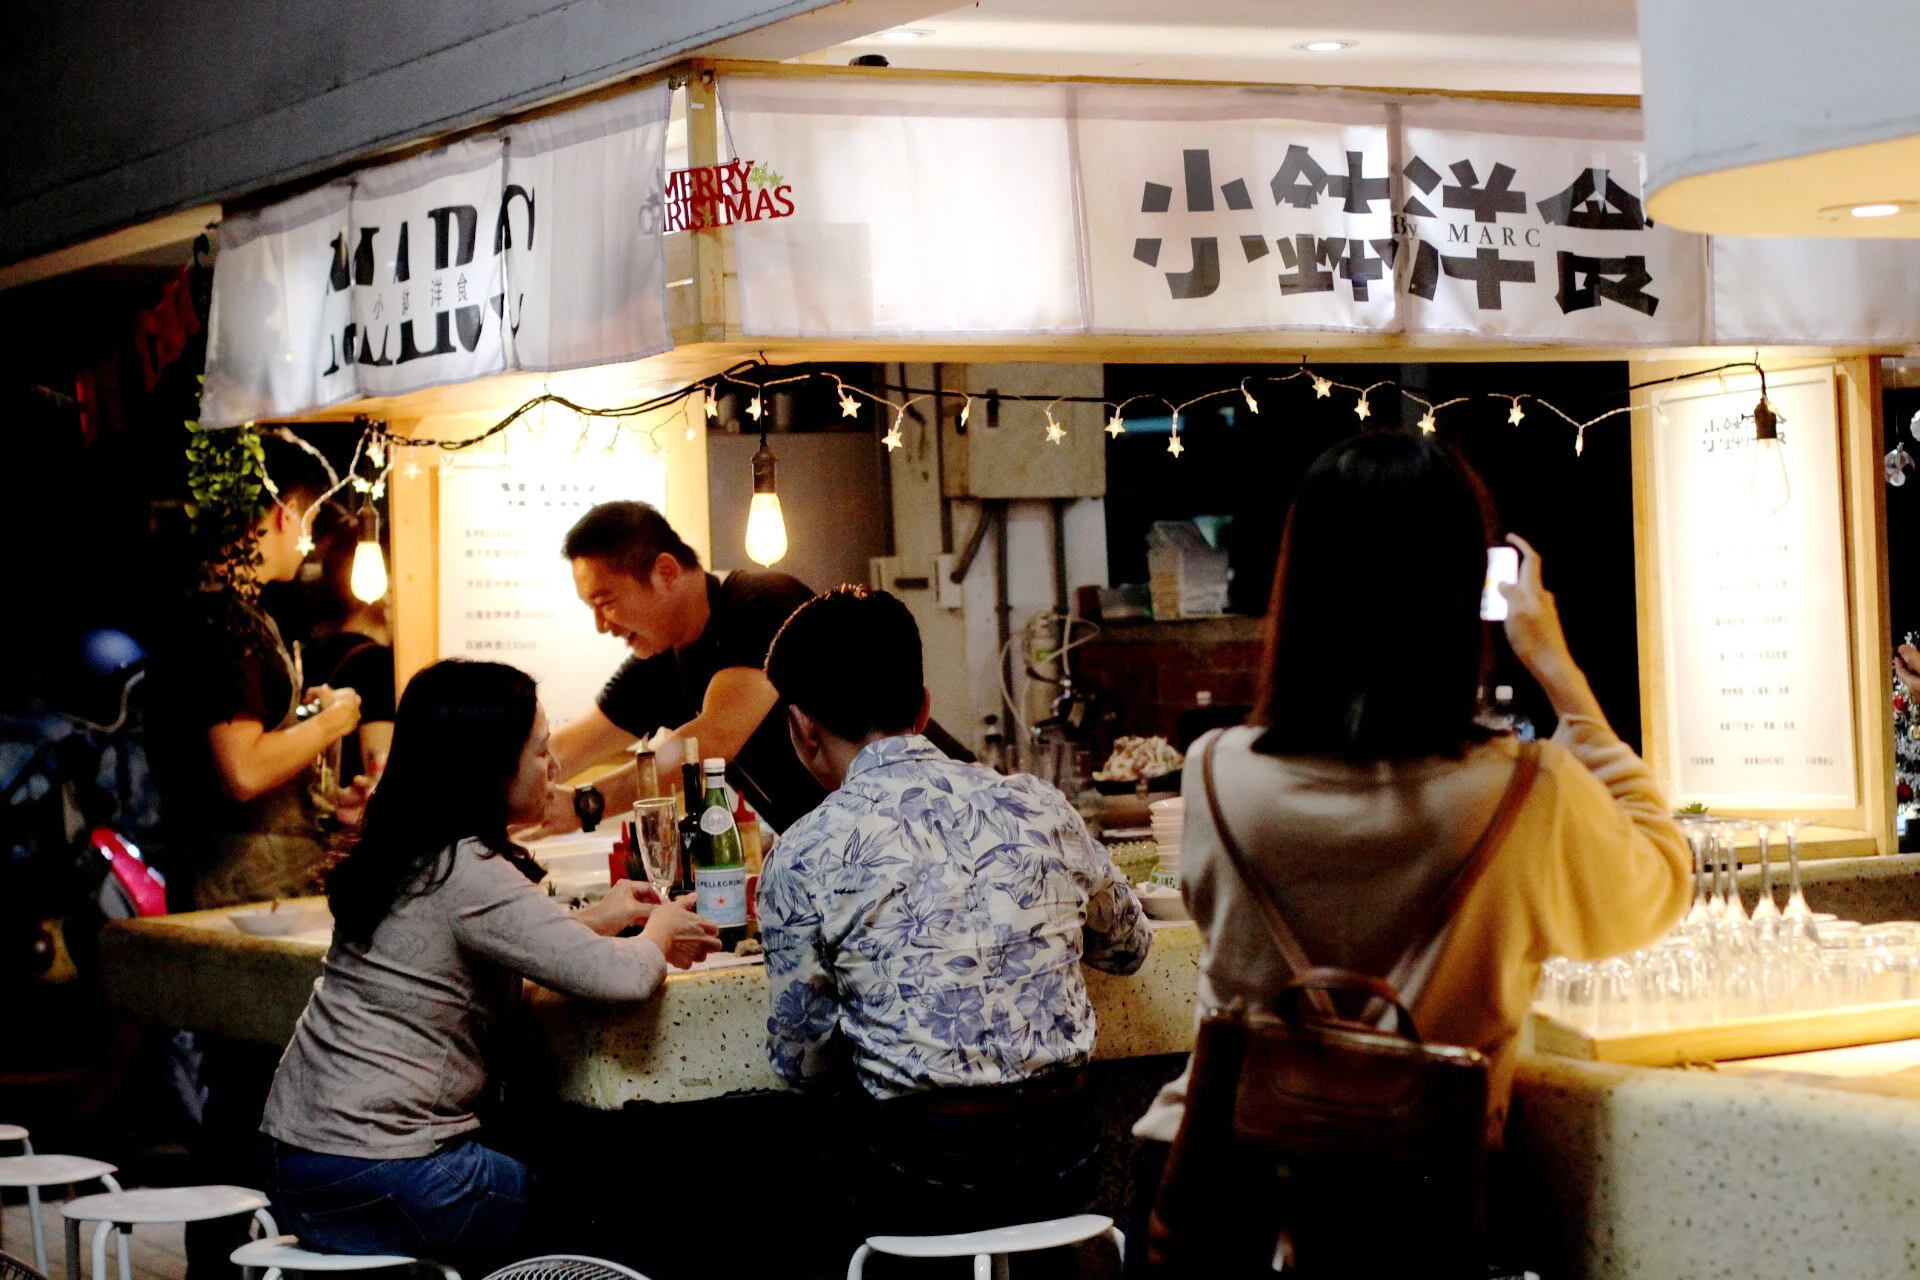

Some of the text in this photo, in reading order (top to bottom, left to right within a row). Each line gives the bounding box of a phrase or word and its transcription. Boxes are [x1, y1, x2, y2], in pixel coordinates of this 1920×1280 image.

[656, 158, 755, 206] MERRY
[1392, 215, 1541, 248] By MARC
